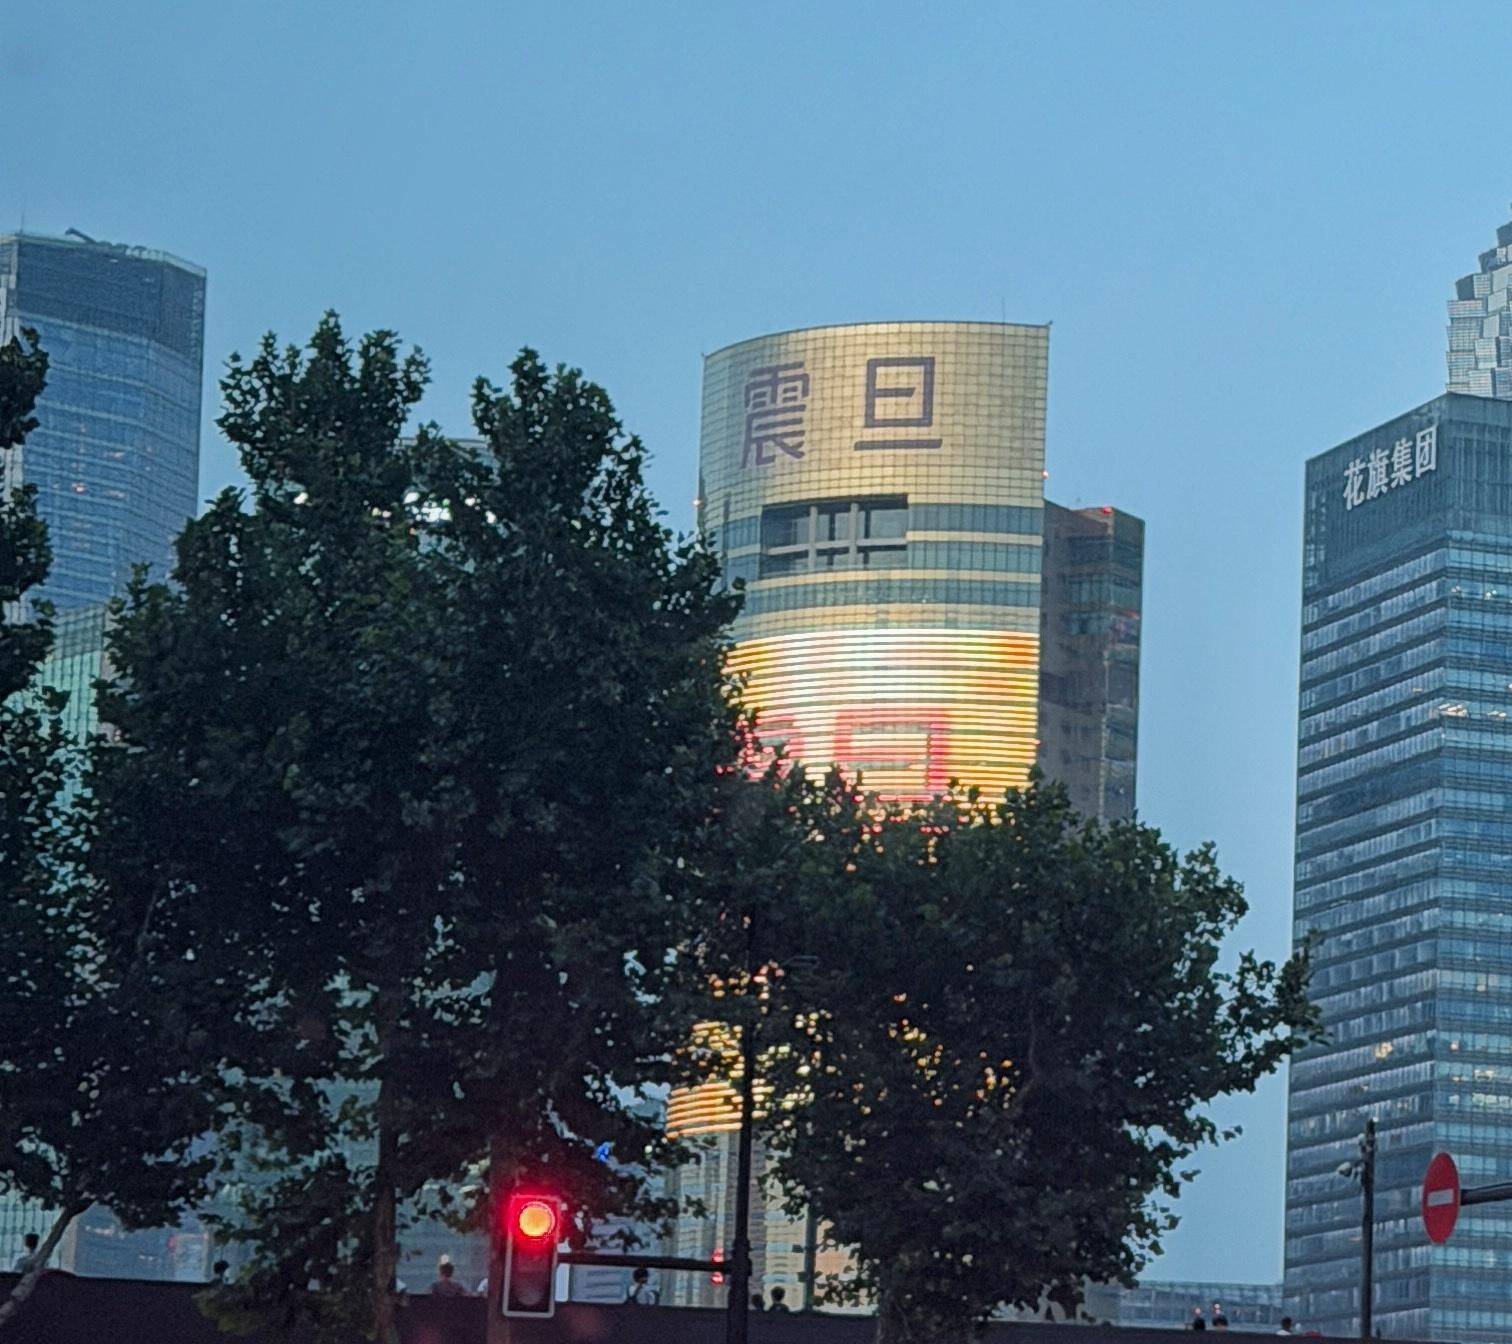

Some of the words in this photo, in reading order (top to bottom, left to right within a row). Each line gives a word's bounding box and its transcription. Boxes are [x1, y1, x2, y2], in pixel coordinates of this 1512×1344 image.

[743, 357, 942, 469] 震旦
[1343, 424, 1438, 510] 花旗集团
